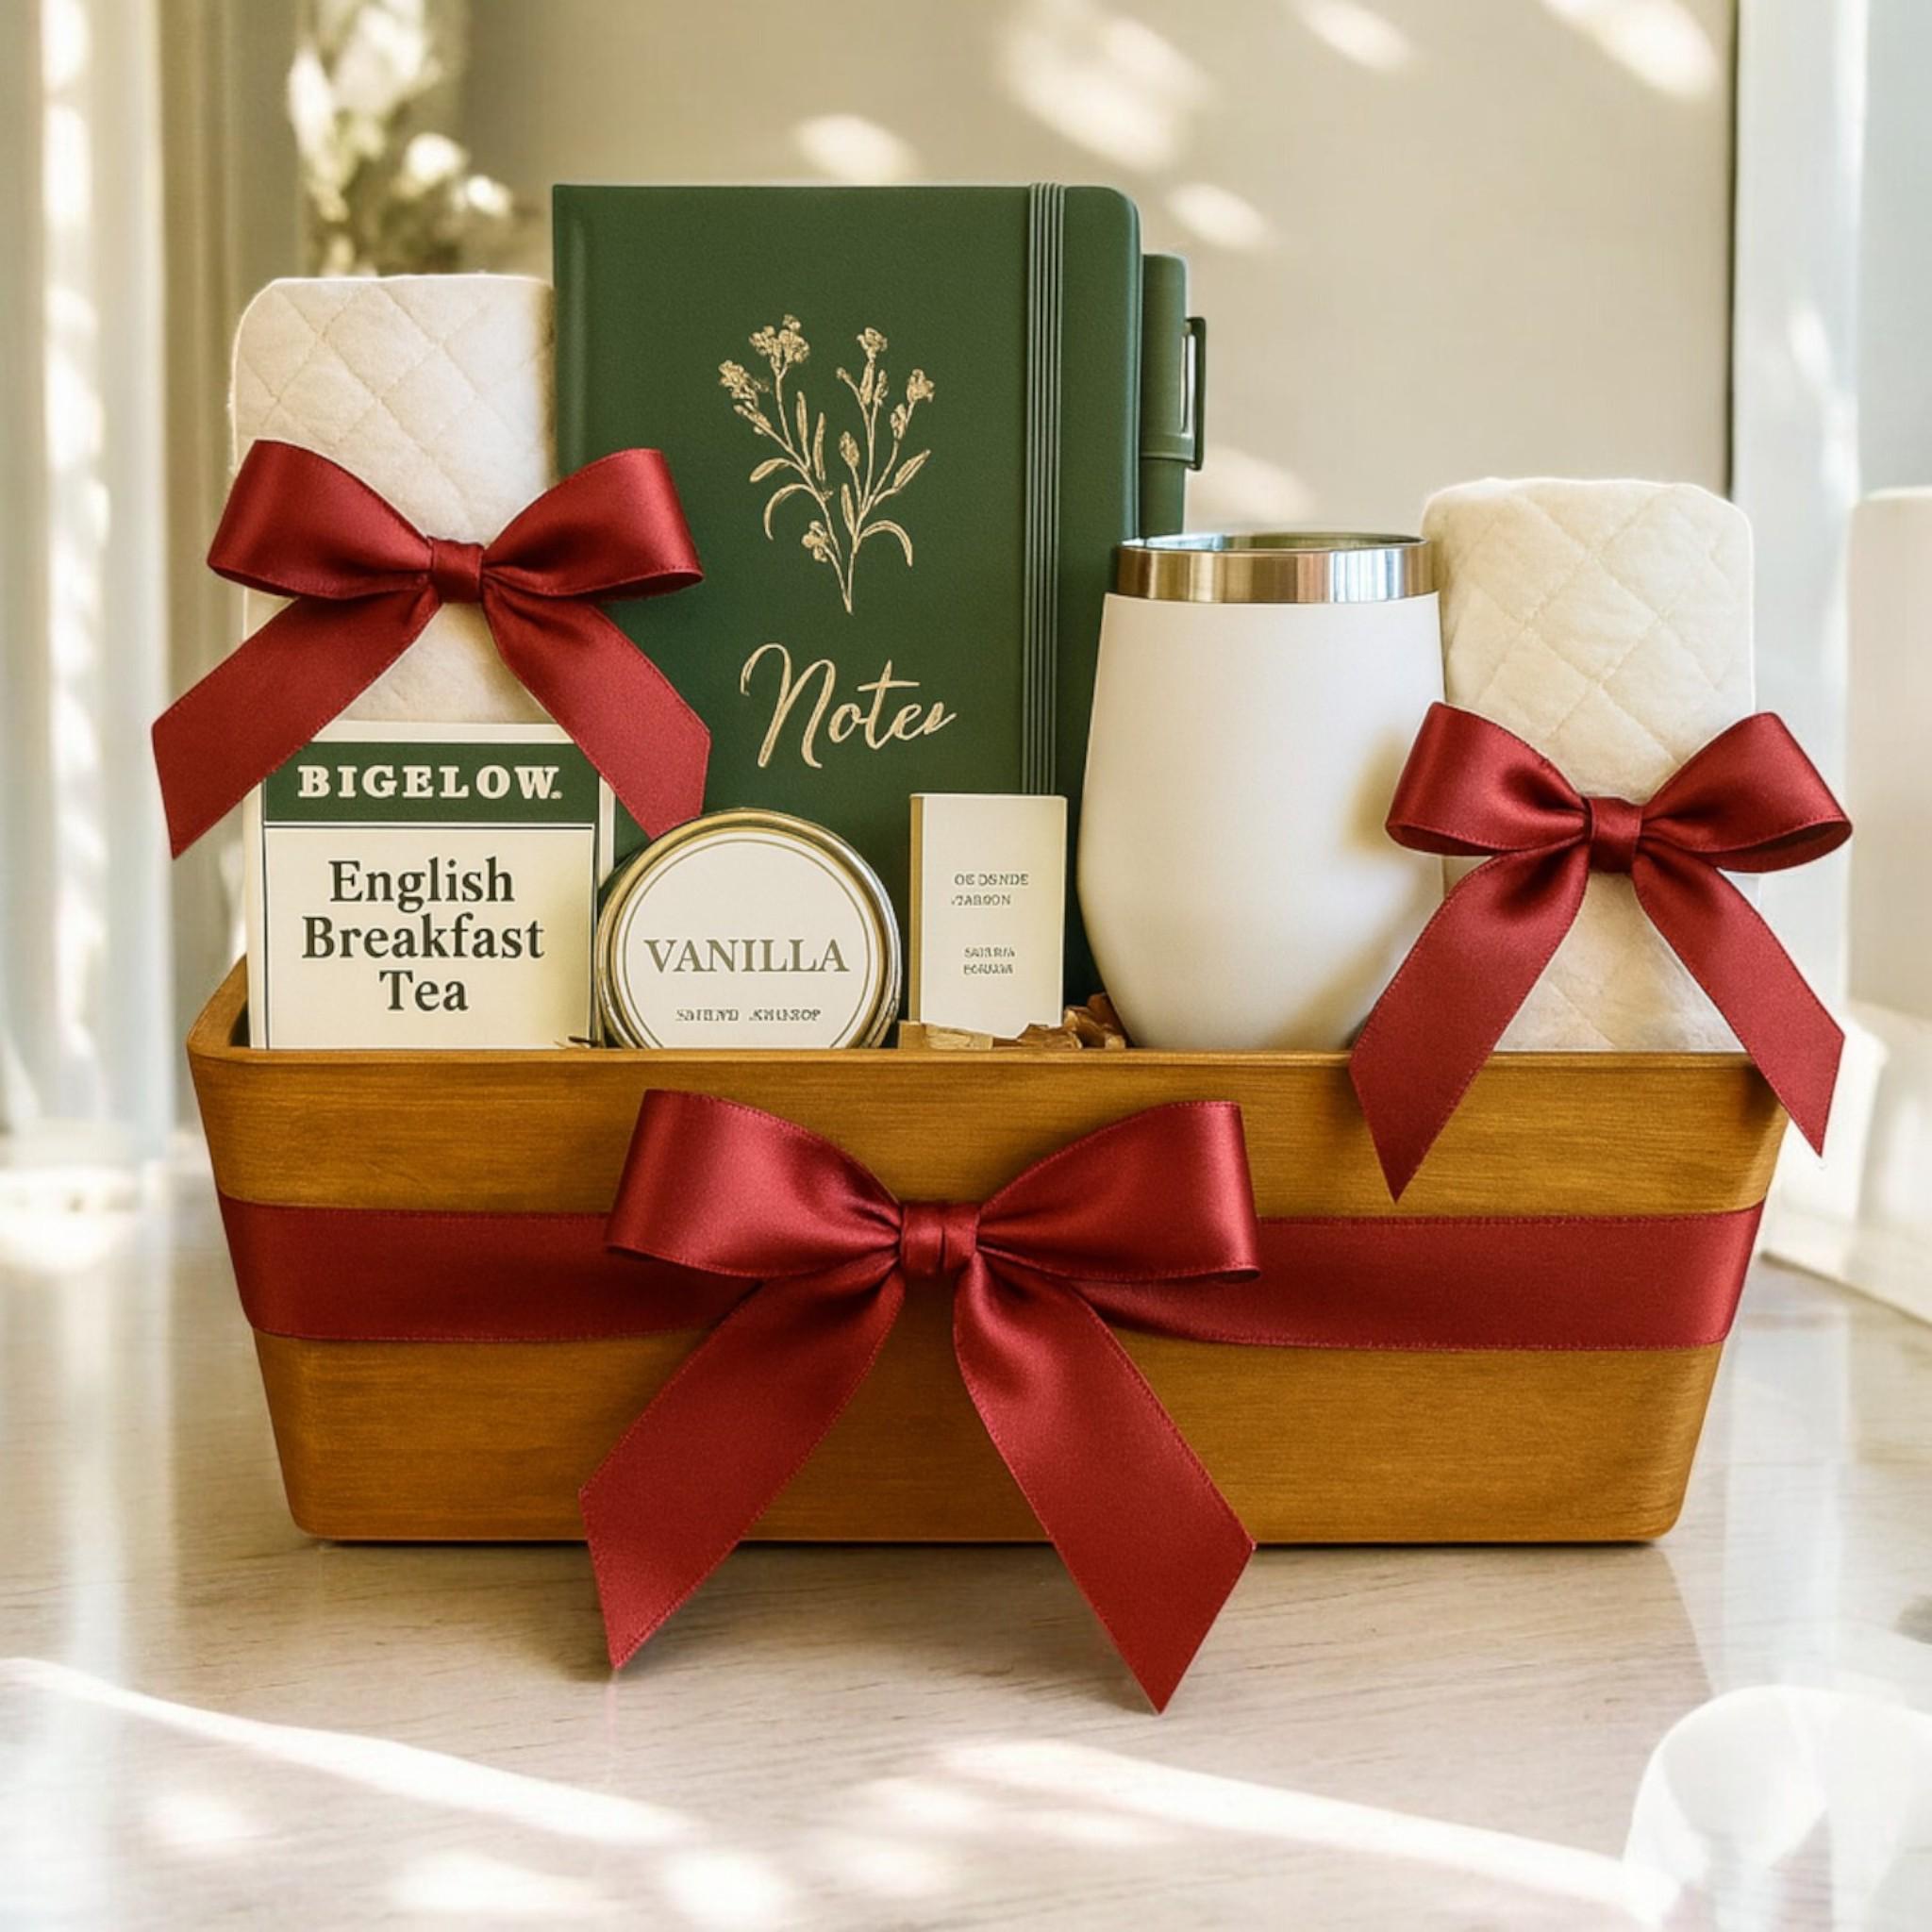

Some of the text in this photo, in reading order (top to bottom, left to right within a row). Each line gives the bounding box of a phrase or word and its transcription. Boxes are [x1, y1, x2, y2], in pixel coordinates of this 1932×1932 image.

[740, 642, 957, 769] Notes
[328, 857, 514, 912] English
[302, 912, 544, 958] Breakfast
[643, 939, 850, 973] VANILLA
[379, 970, 469, 1010] Tea
